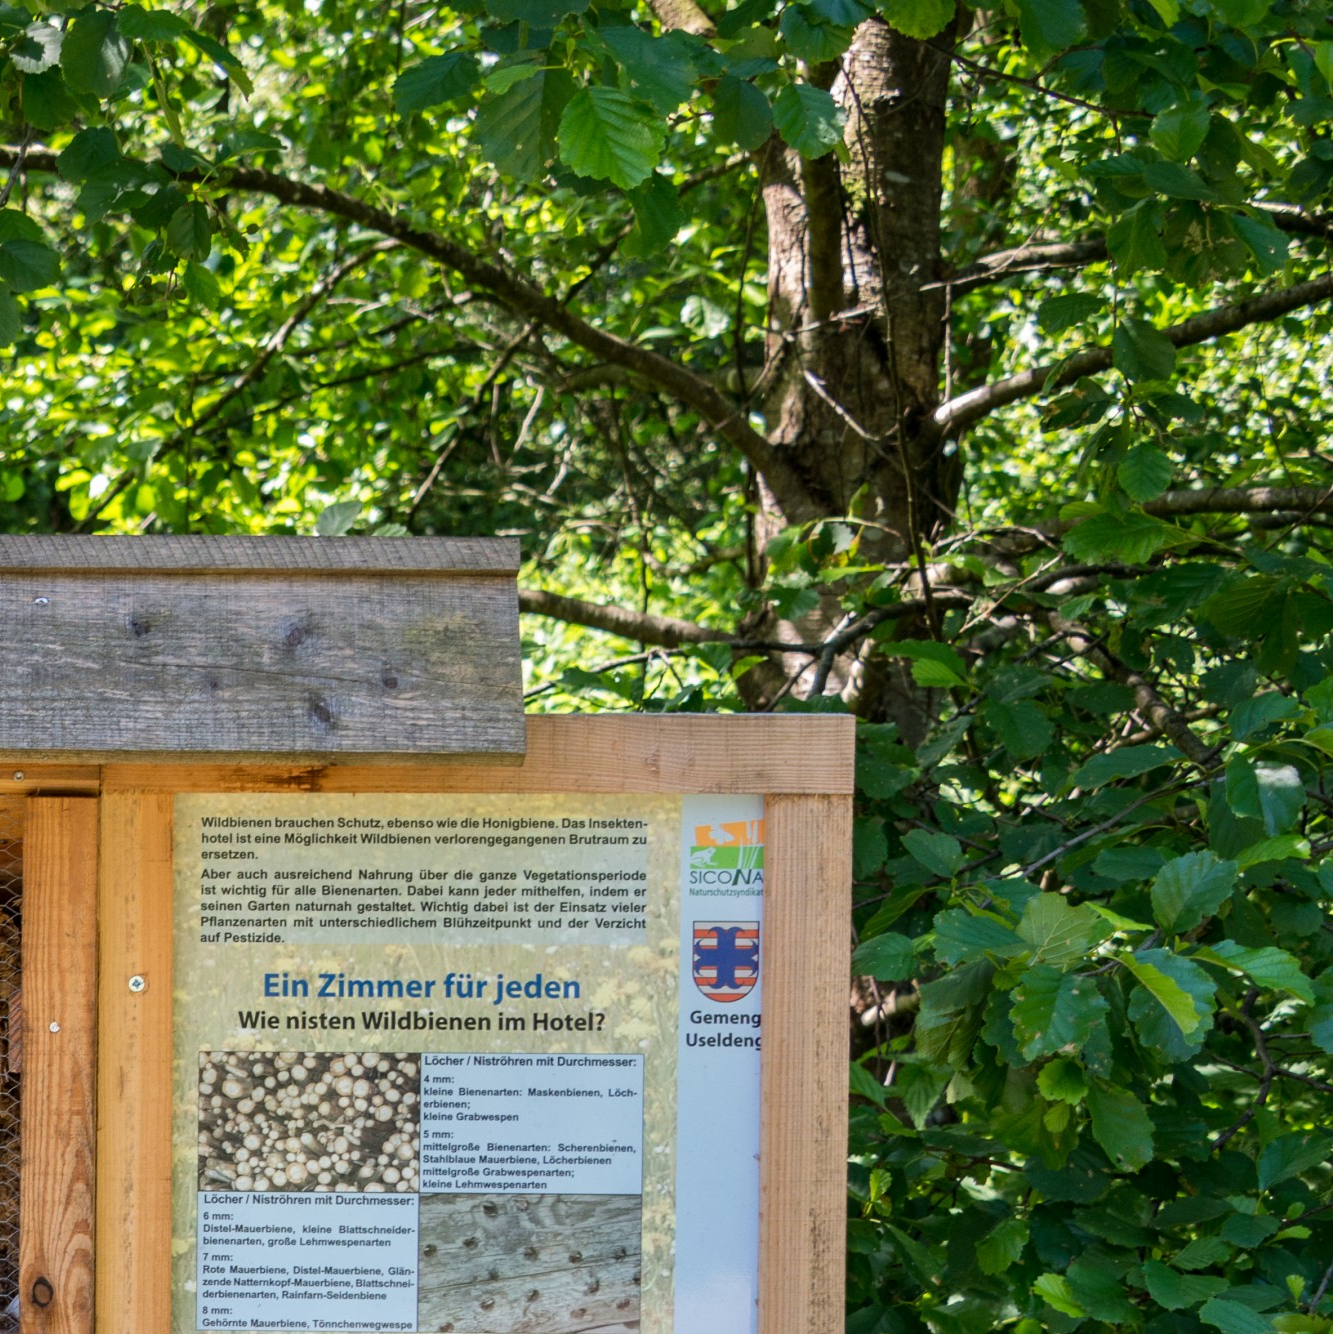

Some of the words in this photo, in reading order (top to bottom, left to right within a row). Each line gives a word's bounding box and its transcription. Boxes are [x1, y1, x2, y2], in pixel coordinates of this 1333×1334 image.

[200, 816, 272, 828] Wildbienen
[274, 816, 335, 828] brauchen
[336, 817, 385, 829] Schutz,
[386, 817, 434, 828] ebenso
[435, 817, 458, 828] wie
[459, 817, 480, 828] die
[481, 817, 560, 831] Honigbiene.
[561, 817, 586, 829] Das
[588, 817, 649, 829] Insekten-
[200, 849, 259, 859] ersetzen.
[689, 868, 764, 886] SICONA
[200, 931, 220, 943] auf
[224, 931, 284, 943] Pestizide.
[263, 973, 309, 998] Ein
[316, 973, 436, 999] Zimmer
[442, 974, 488, 999] für
[492, 974, 581, 1005] jeden
[238, 1010, 280, 1030] Wie
[285, 1010, 355, 1030] nisten
[360, 1011, 491, 1031] Wildbienen
[497, 1011, 526, 1031] im
[532, 1012, 605, 1031] Hotel?
[690, 1010, 762, 1028] Gemeng
[424, 1056, 464, 1066] Löcher
[473, 1056, 533, 1066] Niströhren
[535, 1056, 554, 1066] mit
[557, 1056, 636, 1067] Durchmesser:
[423, 1073, 429, 1083] 4
[432, 1076, 454, 1084] mm:
[423, 1112, 453, 1121] kleine
[455, 1112, 519, 1123] Grabwespen
[423, 1129, 429, 1138] 5
[422, 1179, 452, 1188] kleine
[455, 1179, 547, 1191] Lehmwespenarten
[202, 1211, 209, 1220] 6
[202, 1236, 264, 1247] bienenarten,
[267, 1237, 296, 1248] große
[299, 1237, 390, 1249] Lehmwespenarten
[201, 1305, 208, 1314] 8
[210, 1307, 232, 1315] mm:
[202, 1318, 247, 1327] Gehörnte
[250, 1318, 309, 1329] Mauerbiene,
[312, 1319, 412, 1331] Tönnchenwegwespe
